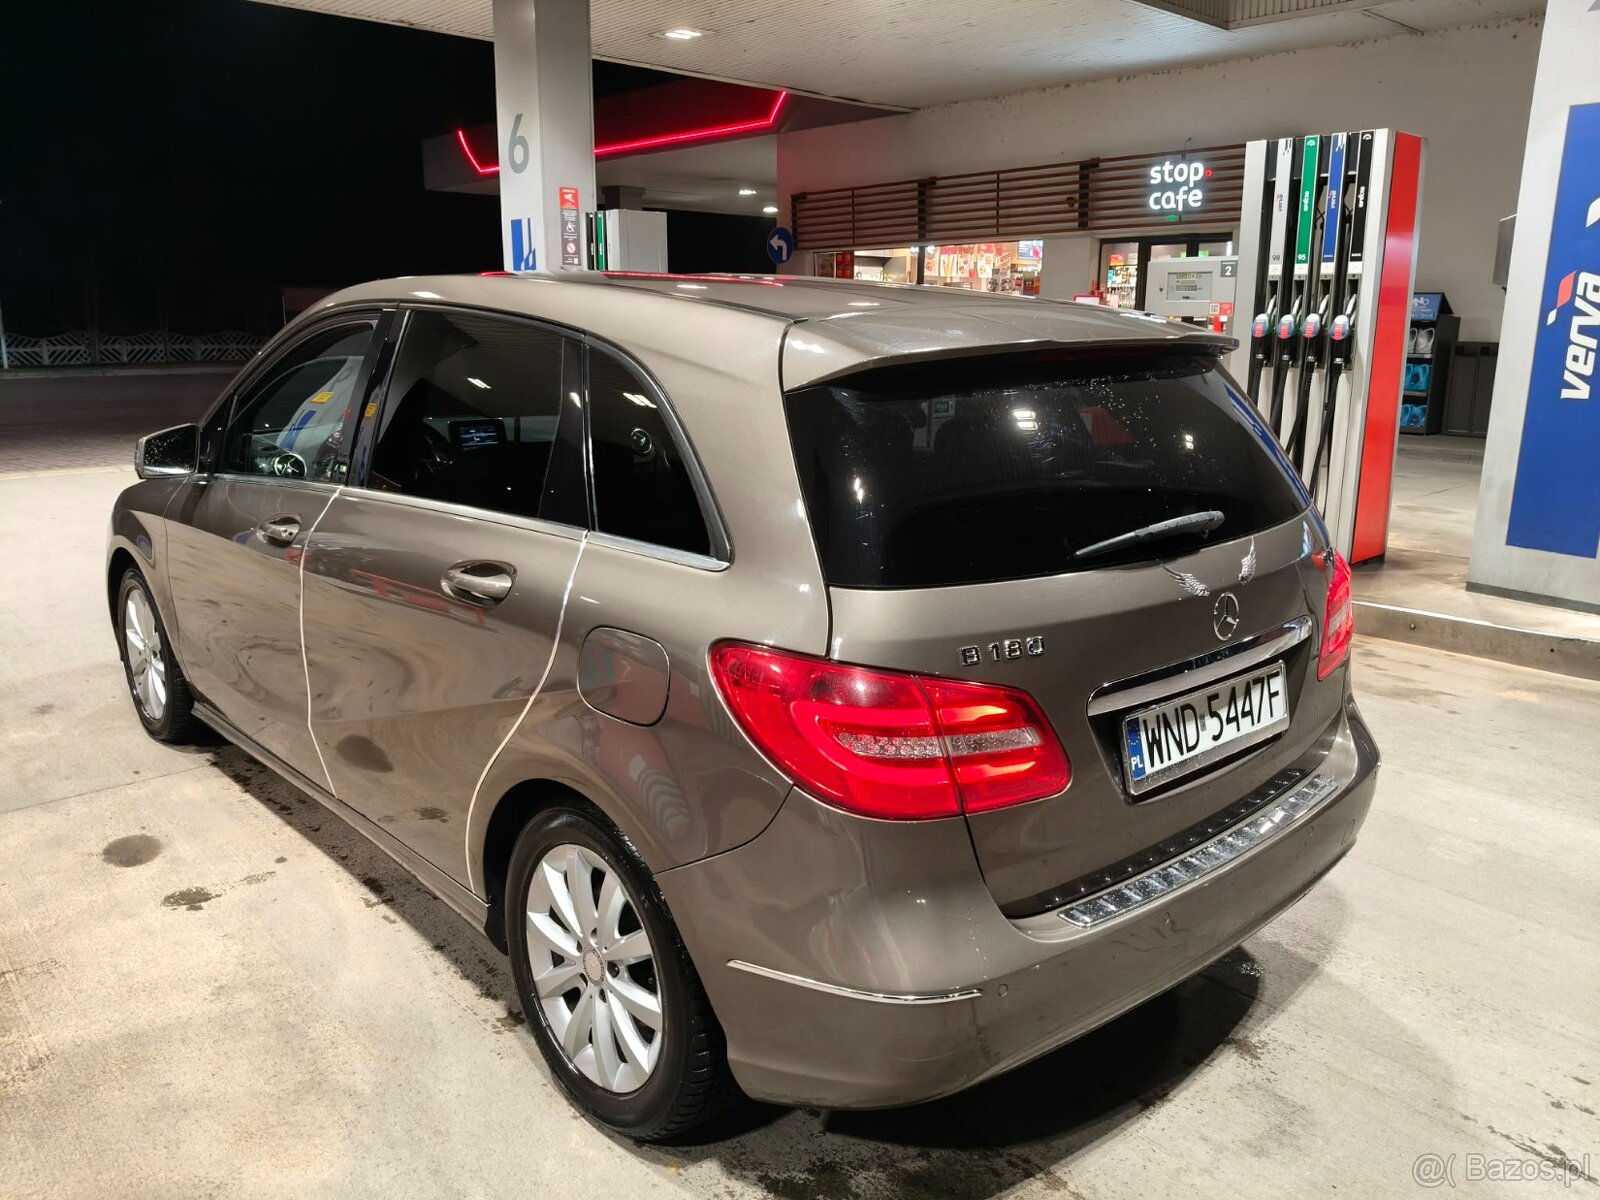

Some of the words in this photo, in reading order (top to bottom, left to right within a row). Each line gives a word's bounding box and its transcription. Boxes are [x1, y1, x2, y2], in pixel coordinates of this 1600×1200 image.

[508, 113, 530, 175] 6
[1149, 185, 1203, 211] cafe
[1225, 265, 1232, 276] 2
[1560, 271, 1600, 400] verva
[960, 645, 981, 666] B
[988, 636, 1045, 661] 180
[1142, 703, 1200, 768] WND
[1207, 671, 1280, 742] 5447F
[1130, 756, 1144, 771] PL
